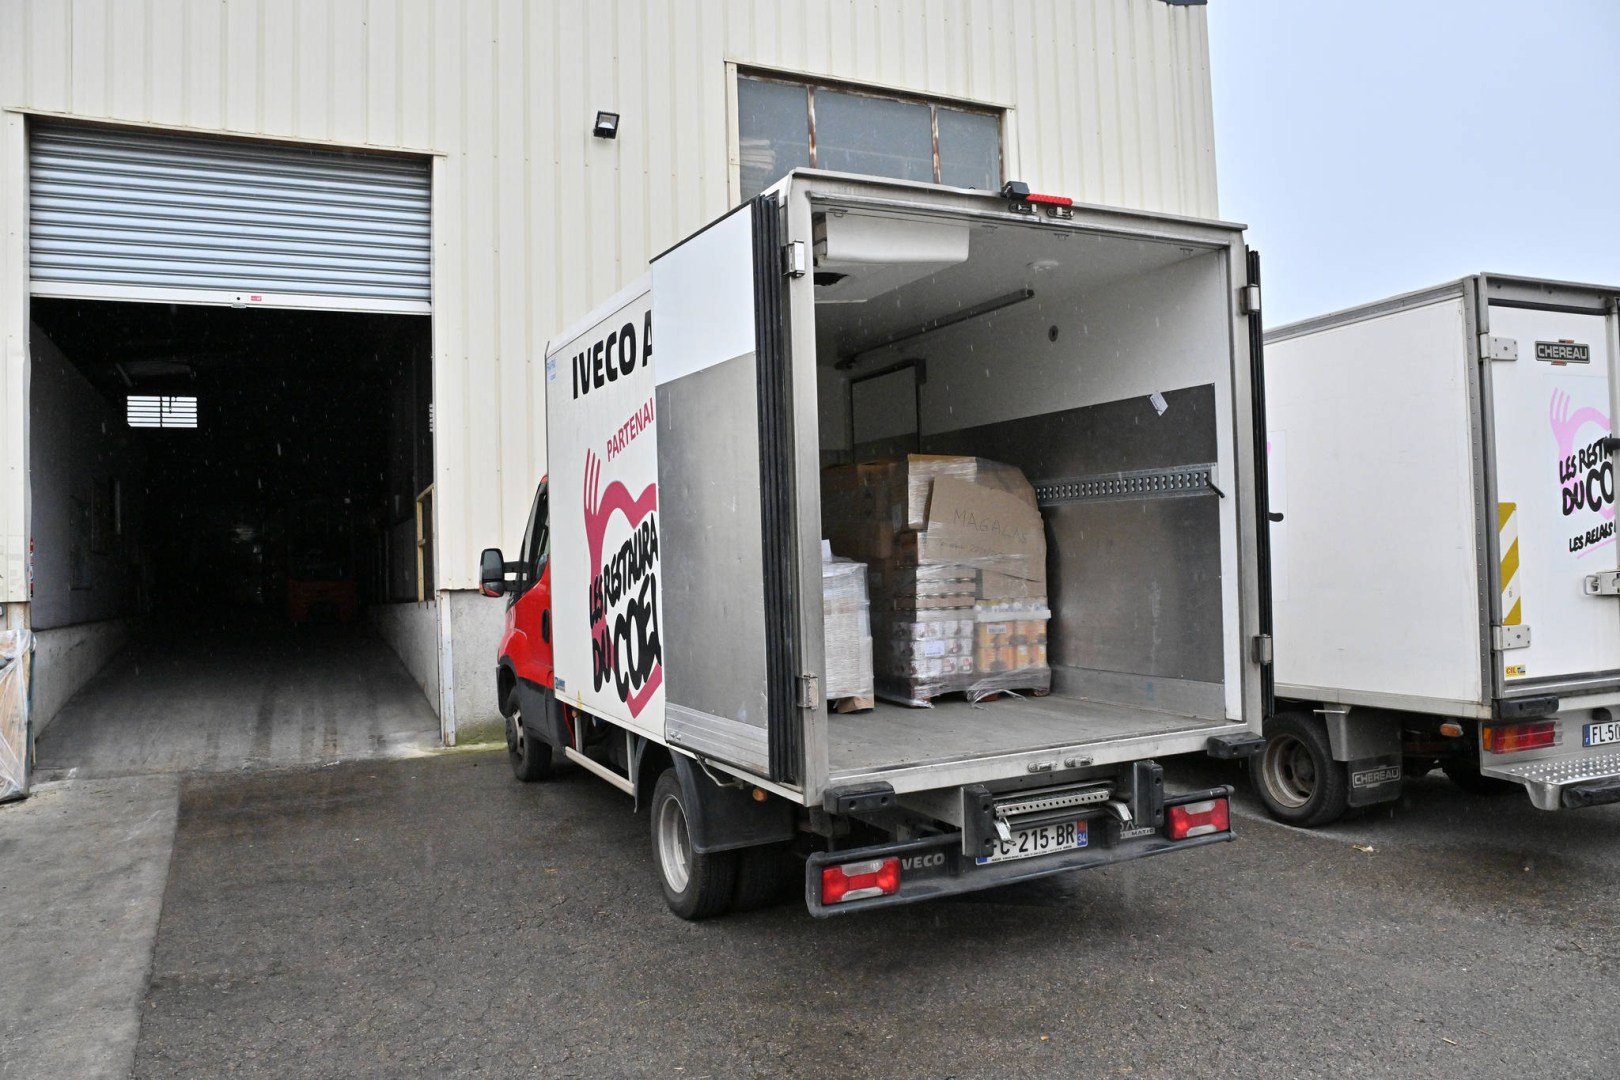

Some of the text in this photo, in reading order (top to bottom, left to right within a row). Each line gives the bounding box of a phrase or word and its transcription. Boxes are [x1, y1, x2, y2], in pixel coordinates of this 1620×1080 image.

[572, 322, 637, 400] IVECO
[1537, 345, 1588, 360] CHEREAU
[606, 397, 655, 463] PARTENAI
[1560, 454, 1577, 485] LES
[1562, 461, 1615, 516] DU CO
[1569, 534, 1584, 553] LES
[1584, 521, 1613, 547] RELAIS
[589, 512, 659, 630] LES RESTAURA
[592, 624, 612, 693] DU
[1354, 768, 1399, 785] CHEREAU
[901, 852, 946, 871] VECO
